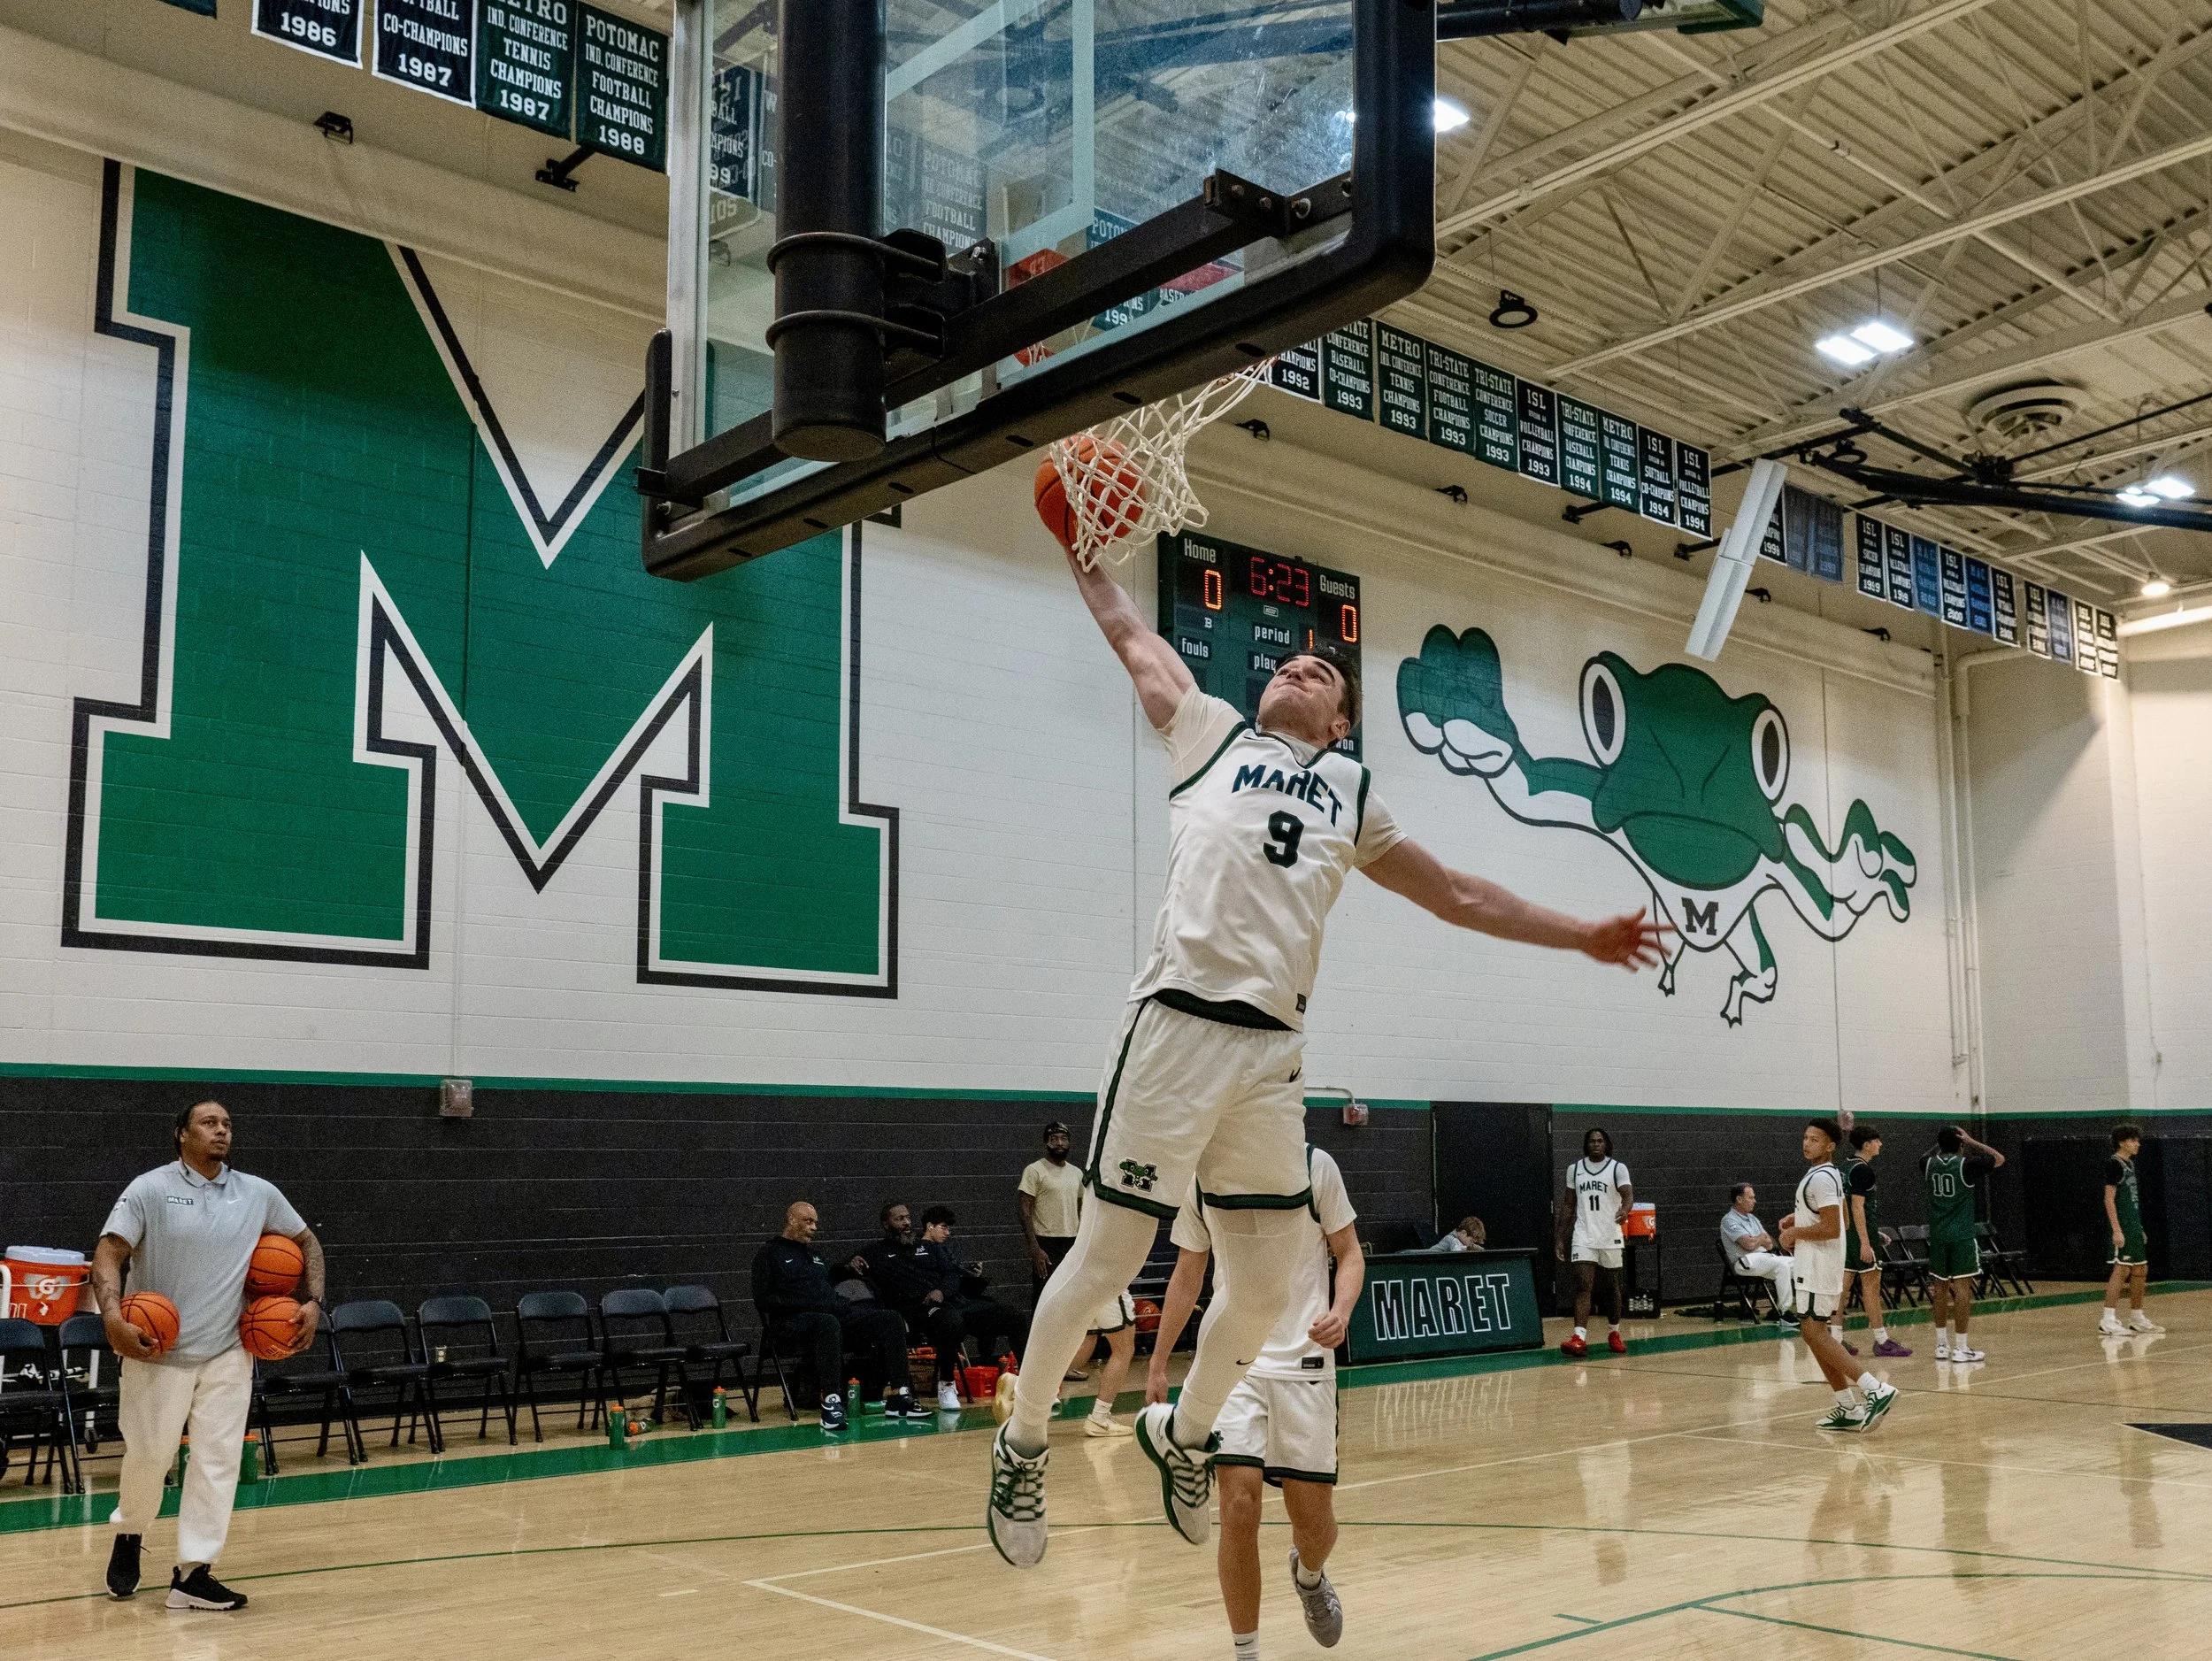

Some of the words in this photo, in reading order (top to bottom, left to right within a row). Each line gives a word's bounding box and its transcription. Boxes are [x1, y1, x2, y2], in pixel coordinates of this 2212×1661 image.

[280, 12, 337, 47] 1986
[383, 12, 468, 58] CO-CHAMPIONS
[488, 5, 506, 29] IND.
[509, 14, 568, 51] CONFERENCE
[586, 14, 659, 63] POTOMAC
[503, 37, 551, 71] TENNIS
[585, 43, 603, 67] IND.
[605, 51, 658, 88] CONFERENCE
[398, 53, 453, 87] 1987
[490, 58, 562, 99] CHAMPIONS
[592, 70, 652, 111] FOOTBALL
[500, 89, 550, 121] 1987
[590, 95, 653, 135] CHAMPIONS
[599, 125, 645, 155] 1988
[926, 199, 976, 232] FOOTBALL
[1327, 333, 1369, 358] CONFERENCE
[1381, 330, 1421, 359] METRO
[1280, 351, 1317, 373] HAMPIONS
[1331, 350, 1366, 375] BASEBALL
[1392, 355, 1423, 379] CONFERENCE
[1429, 350, 1470, 379] TRI-STATE
[1282, 368, 1310, 391] 1992
[1329, 367, 1371, 394] CO-CHAMPIONS
[1390, 373, 1415, 394] TENNIS
[1429, 370, 1471, 396] CONFERENCE
[1475, 368, 1513, 396] TRI-STATE
[1337, 390, 1363, 411] 1993
[1383, 389, 1421, 414] CHAMPIONS
[1433, 388, 1469, 412] FOOTBALL
[1475, 388, 1514, 413] CONFERENCE
[1526, 388, 1547, 411] ISL
[1391, 410, 1417, 429] 1993
[1433, 407, 1471, 430] CHAMPIONS
[1484, 408, 1508, 428] SOCCER
[1561, 401, 1596, 427] TRI-STATE
[1440, 427, 1466, 446] 1993
[1479, 424, 1515, 447] CHAMPIONS
[1520, 419, 1555, 443] VOLLEYBALL
[1563, 420, 1597, 443] CONFERENCE
[1602, 416, 1633, 441] METRO
[1486, 443, 1509, 462] 1993
[1522, 439, 1555, 460] CHAMPIONS
[1647, 434, 1665, 455] ISL
[1528, 458, 1550, 477] 1993
[1565, 455, 1596, 476] CHAMPIONS
[1684, 450, 1701, 469] ISL
[1570, 473, 1592, 492] 1994
[1607, 469, 1636, 489] CHAMPIONS
[1644, 465, 1671, 484] SOFTBALL
[1610, 488, 1632, 505] 1994
[1681, 496, 1709, 515] CHAMPIONS
[1648, 500, 1670, 518] 1994
[1685, 514, 1706, 531] 1994
[1863, 520, 1877, 537] ISL
[1184, 538, 1217, 564] Home
[1891, 532, 1905, 548] ISL
[1204, 569, 1223, 611] 0
[1250, 556, 1310, 606] 6:23
[1319, 574, 1356, 600] Guests
[1254, 625, 1290, 644] period
[1340, 604, 1357, 643] 0
[1181, 637, 1210, 657] fouls
[1232, 764, 1343, 827] MARET
[1263, 810, 1305, 869] 9
[1681, 897, 1719, 936] M
[1579, 1180, 1609, 1194] MARET
[1932, 1173, 1955, 1197] 10
[1589, 1195, 1601, 1211] 11
[1371, 1273, 1512, 1341] MARET
